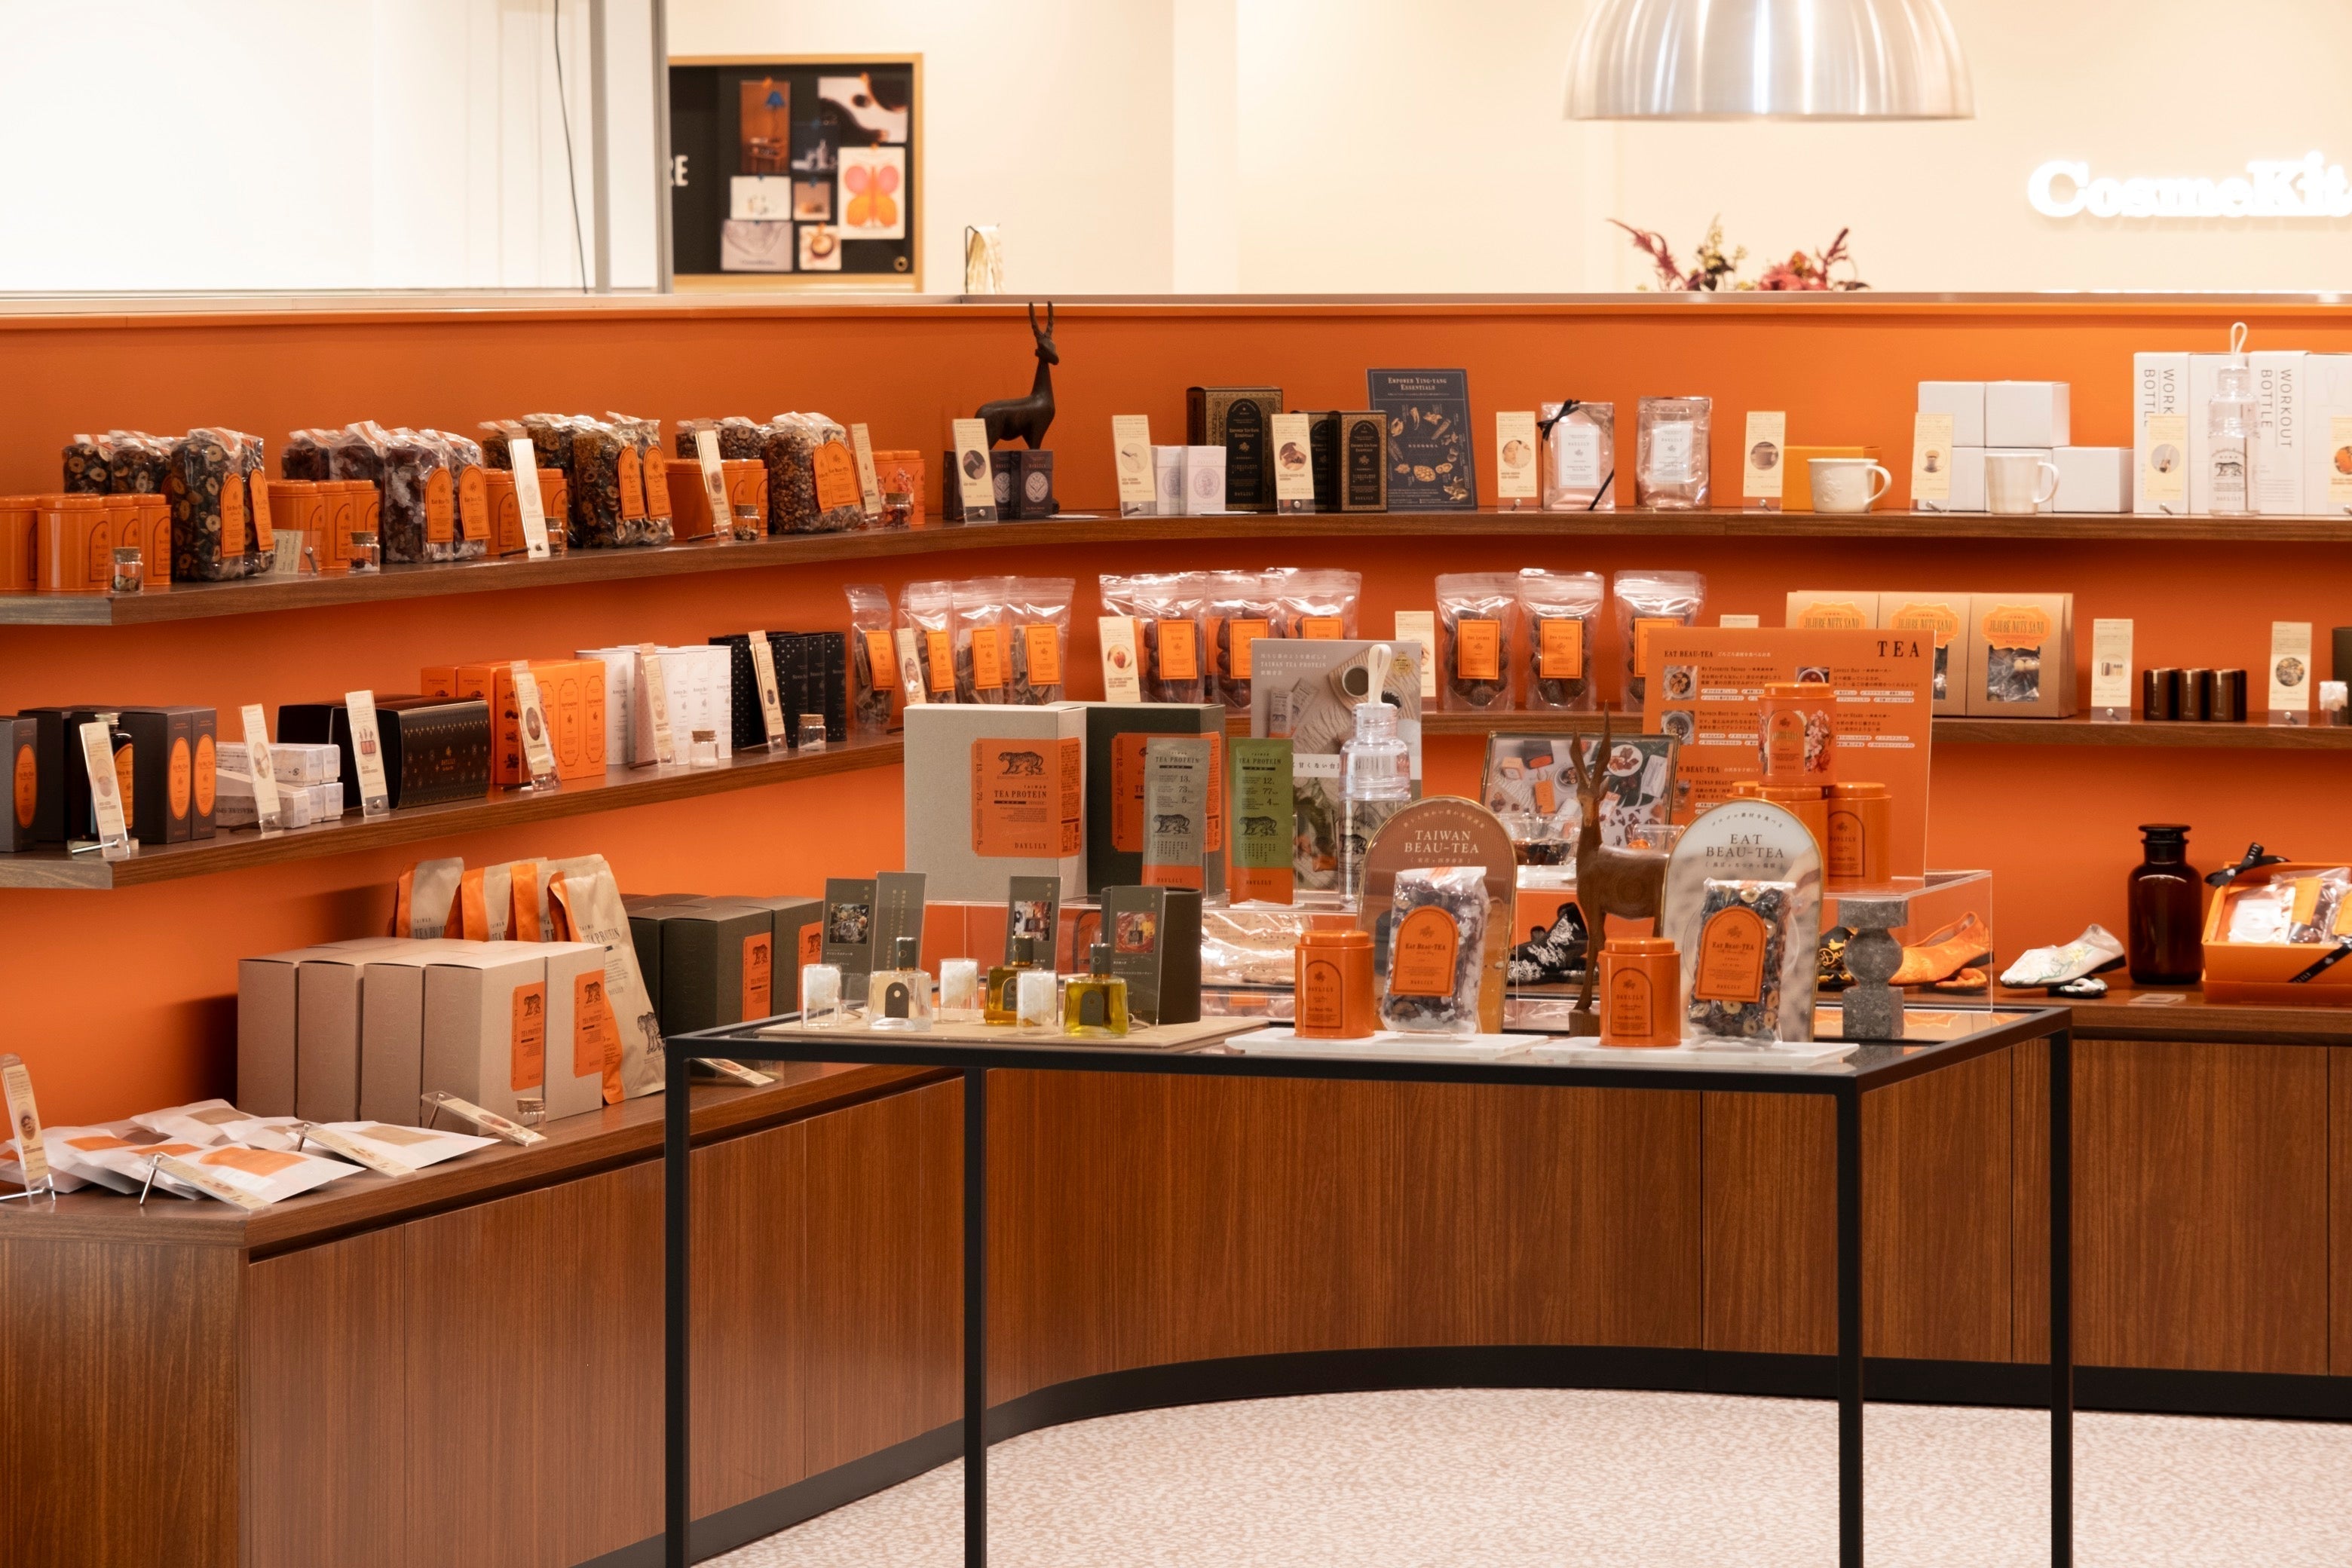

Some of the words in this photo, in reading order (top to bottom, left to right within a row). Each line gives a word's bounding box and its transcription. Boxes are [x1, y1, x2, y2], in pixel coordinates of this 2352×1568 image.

[671, 155, 688, 186] E
[2163, 369, 2175, 415] WORK
[2260, 369, 2273, 428] BOTTLE
[2280, 369, 2292, 448] WORKOUT
[1877, 641, 1919, 657] TEA
[1415, 830, 1471, 841] TAIWAN
[1730, 834, 1762, 844] EAT
[1404, 843, 1478, 853] BEAU-TEA
[1706, 847, 1784, 858] BEAU-TEA
[544, 929, 554, 942] TE
